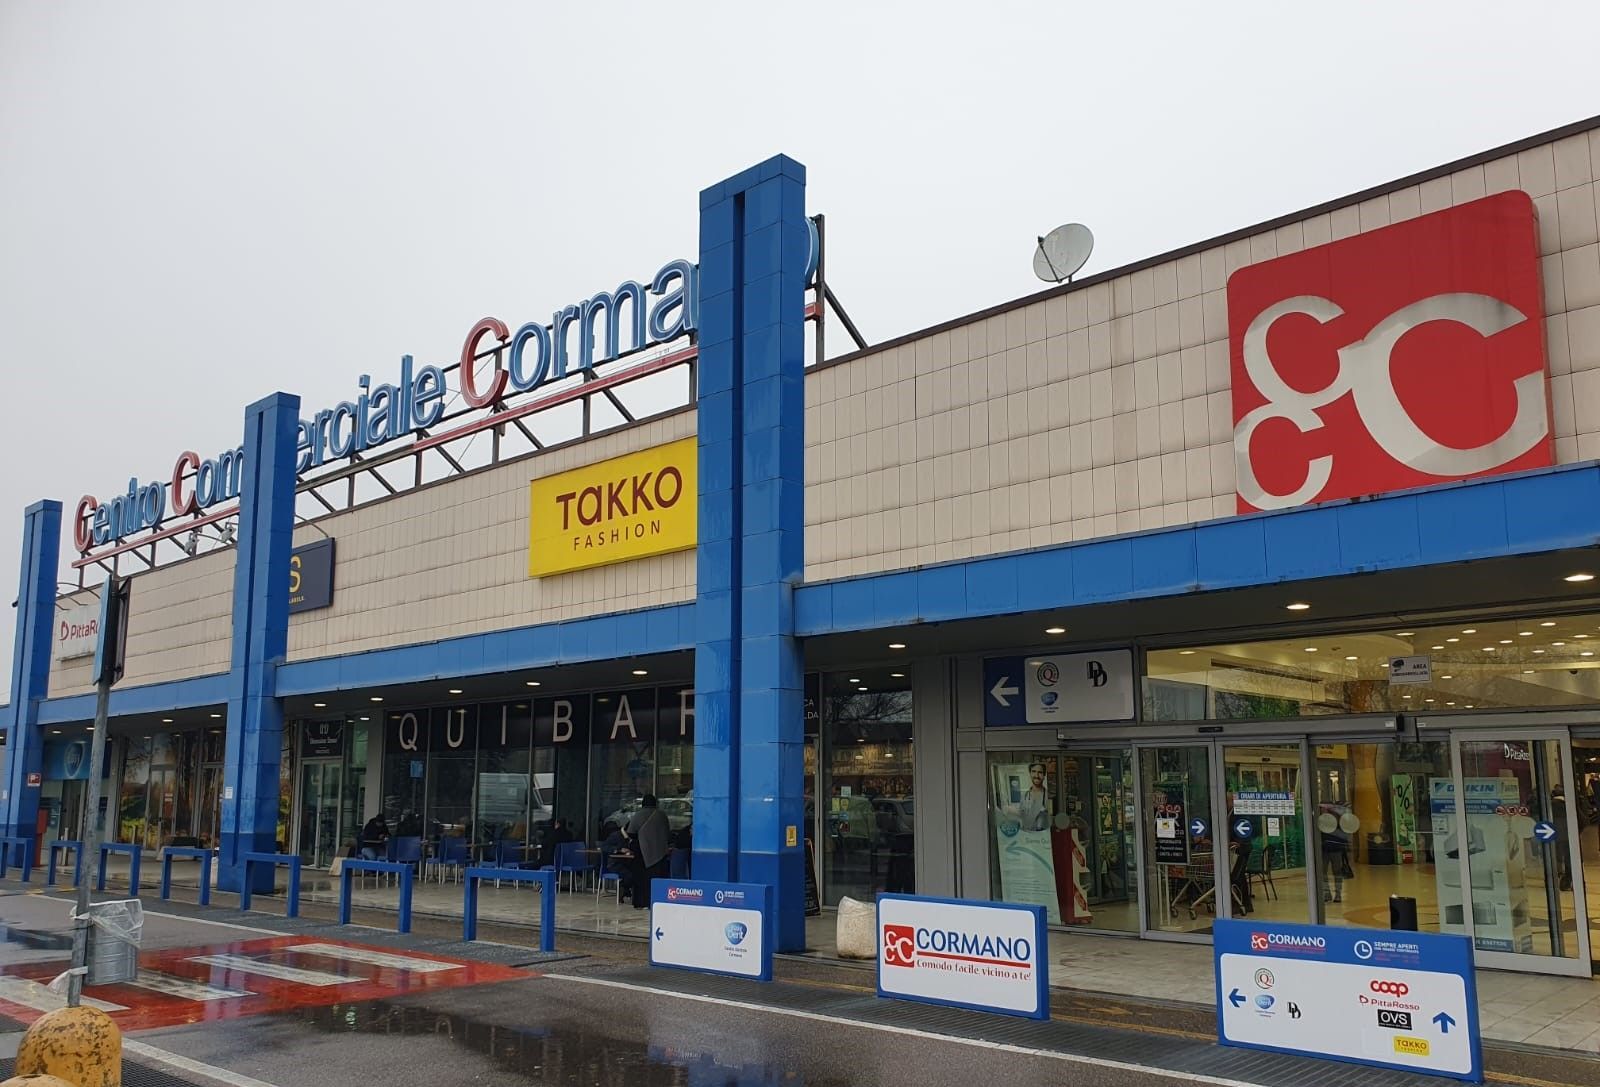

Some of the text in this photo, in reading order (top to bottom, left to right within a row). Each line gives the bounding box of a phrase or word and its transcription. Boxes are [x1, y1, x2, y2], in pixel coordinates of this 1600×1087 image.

[75, 477, 167, 552] Centro
[573, 519, 661, 551] FASHION
[1447, 784, 1496, 792] DIKIN
[916, 928, 1031, 961] CORMANO
[1268, 933, 1326, 948] CORMANO
[916, 959, 952, 971] Comodo
[982, 966, 1010, 979] vicino
[1370, 980, 1409, 998] coop
[1370, 998, 1420, 1011] PittaRosso
[1380, 1011, 1408, 1025] OVS
